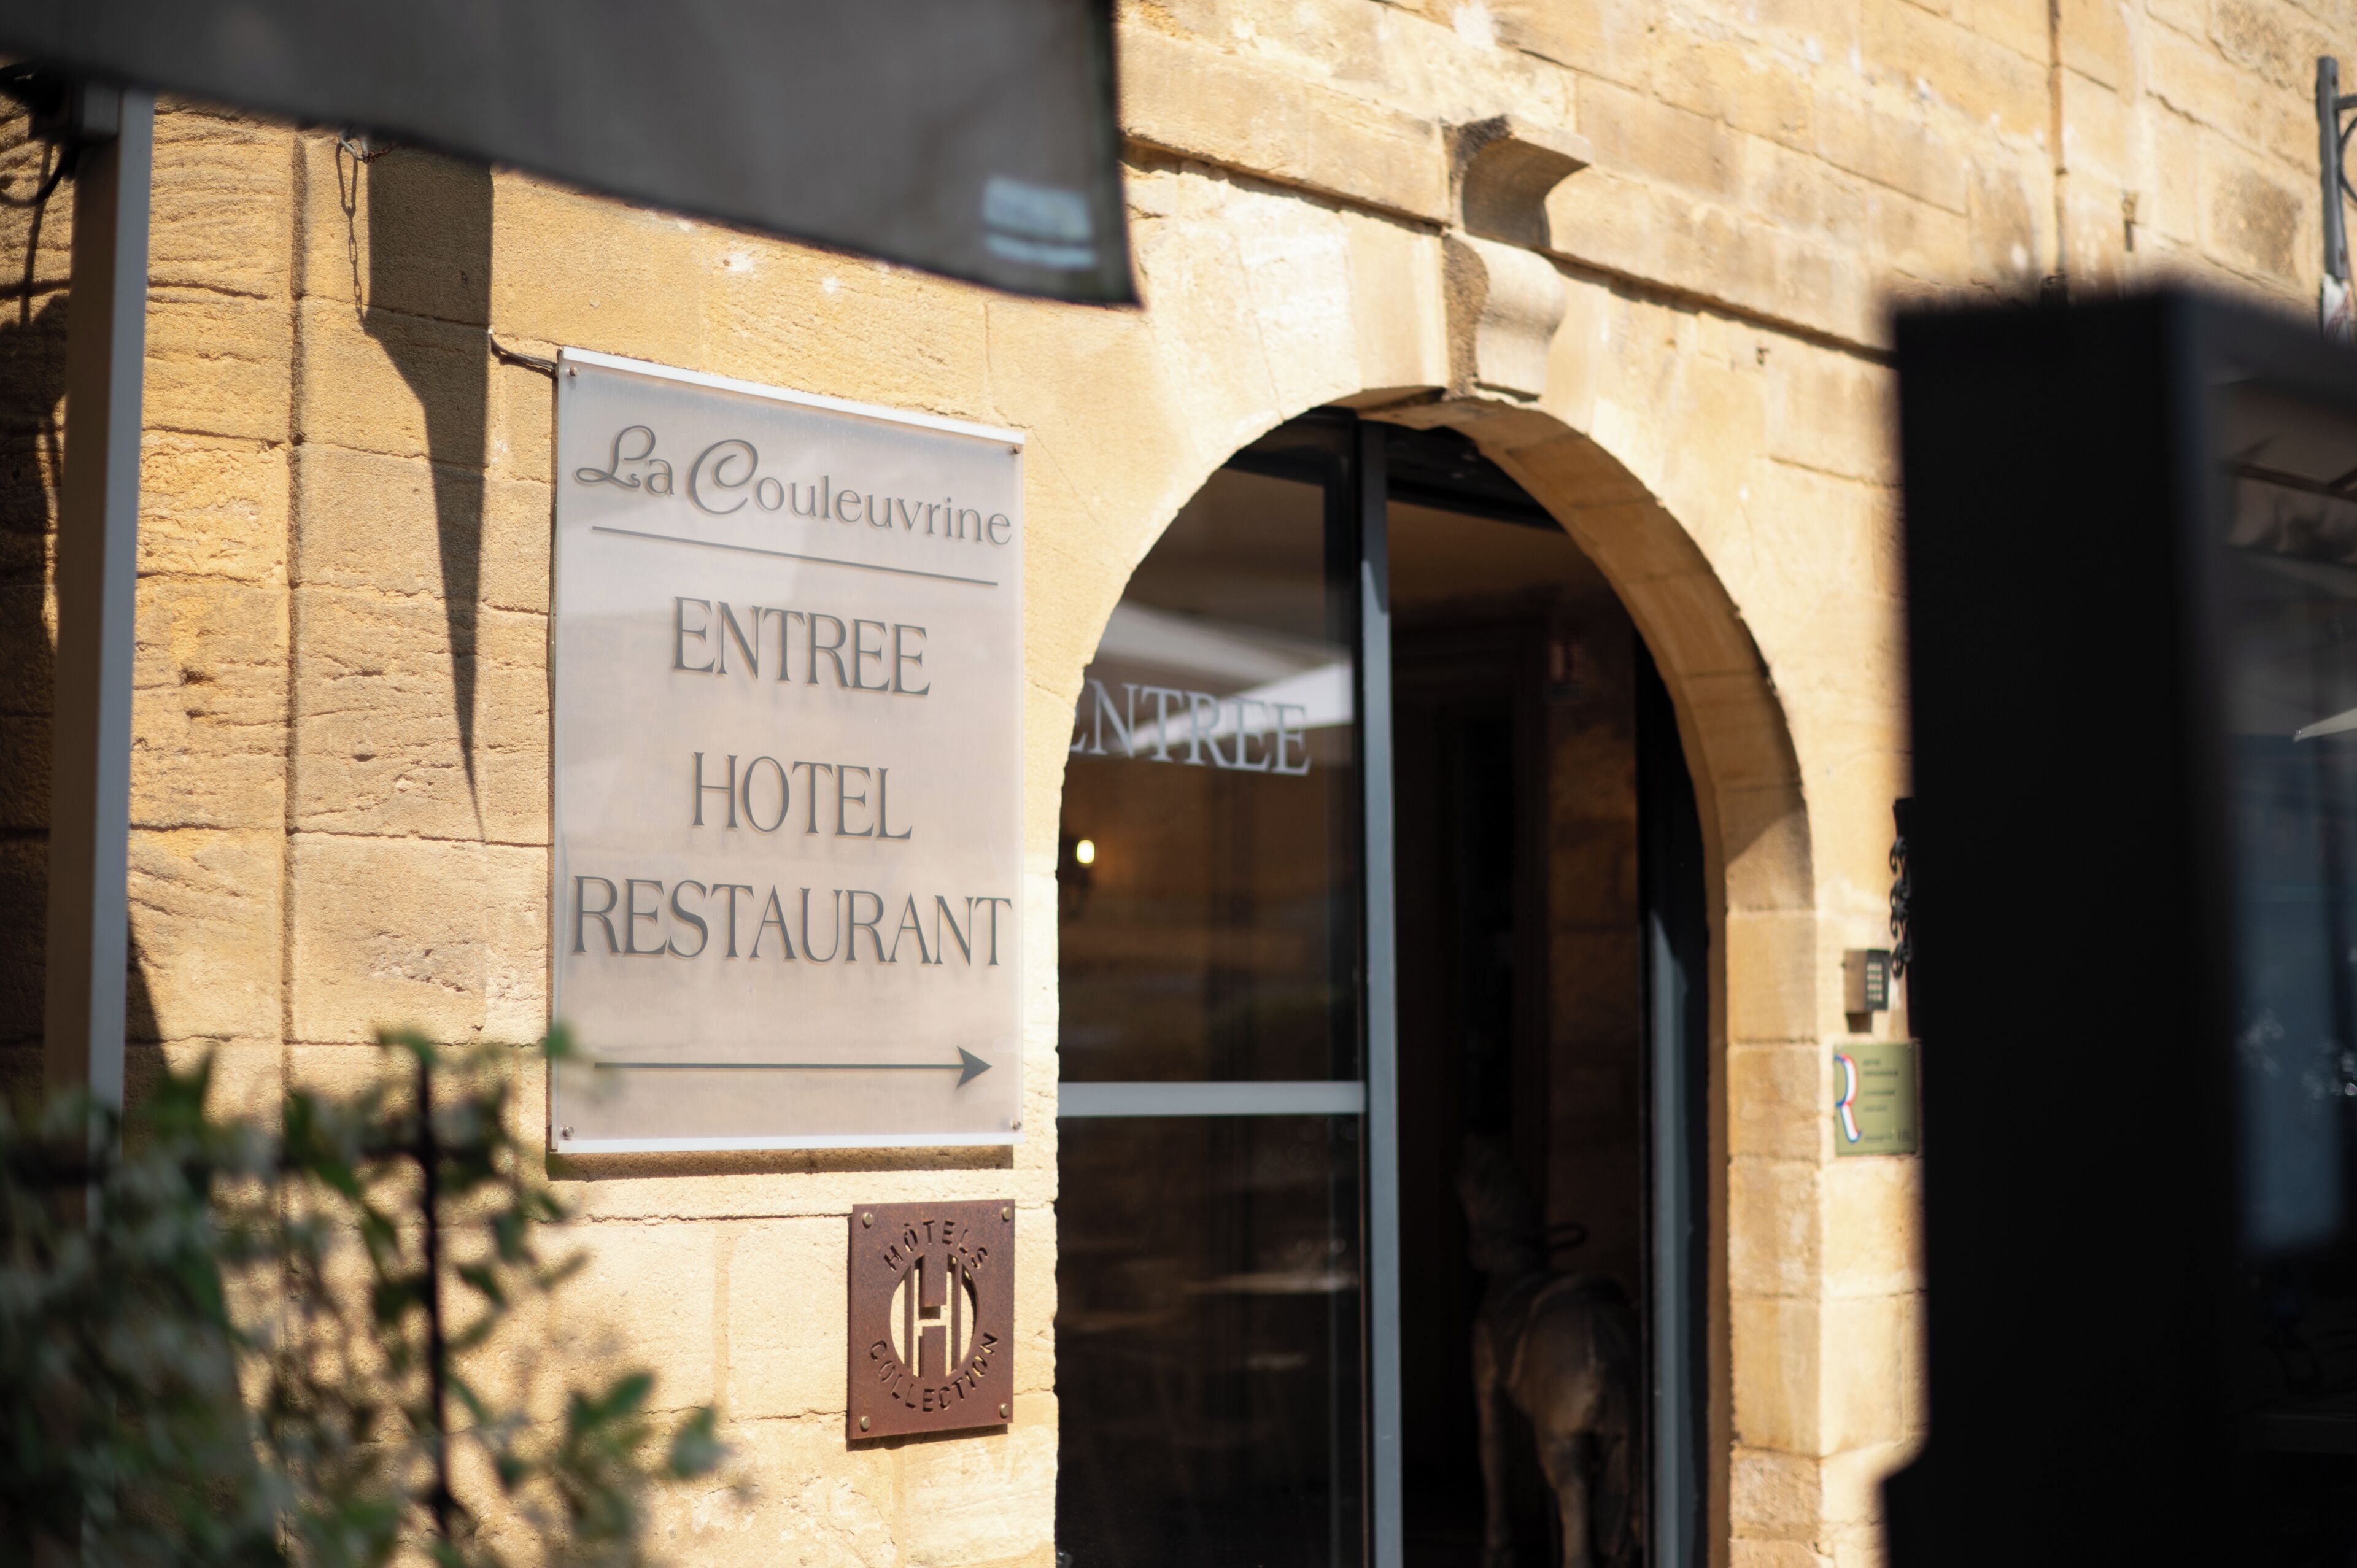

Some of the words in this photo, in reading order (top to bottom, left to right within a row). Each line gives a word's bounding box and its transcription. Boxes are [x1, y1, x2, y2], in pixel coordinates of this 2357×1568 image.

[574, 425, 675, 496] La
[688, 439, 1012, 546] Couleuvrine
[673, 596, 931, 696] ENTREE
[1069, 678, 1312, 776] NTREE
[692, 751, 913, 840] HOTEL
[572, 875, 1012, 967] RESTAURANT
[883, 1219, 989, 1272] HÔTELS
[869, 1332, 999, 1412] COLLECTION
